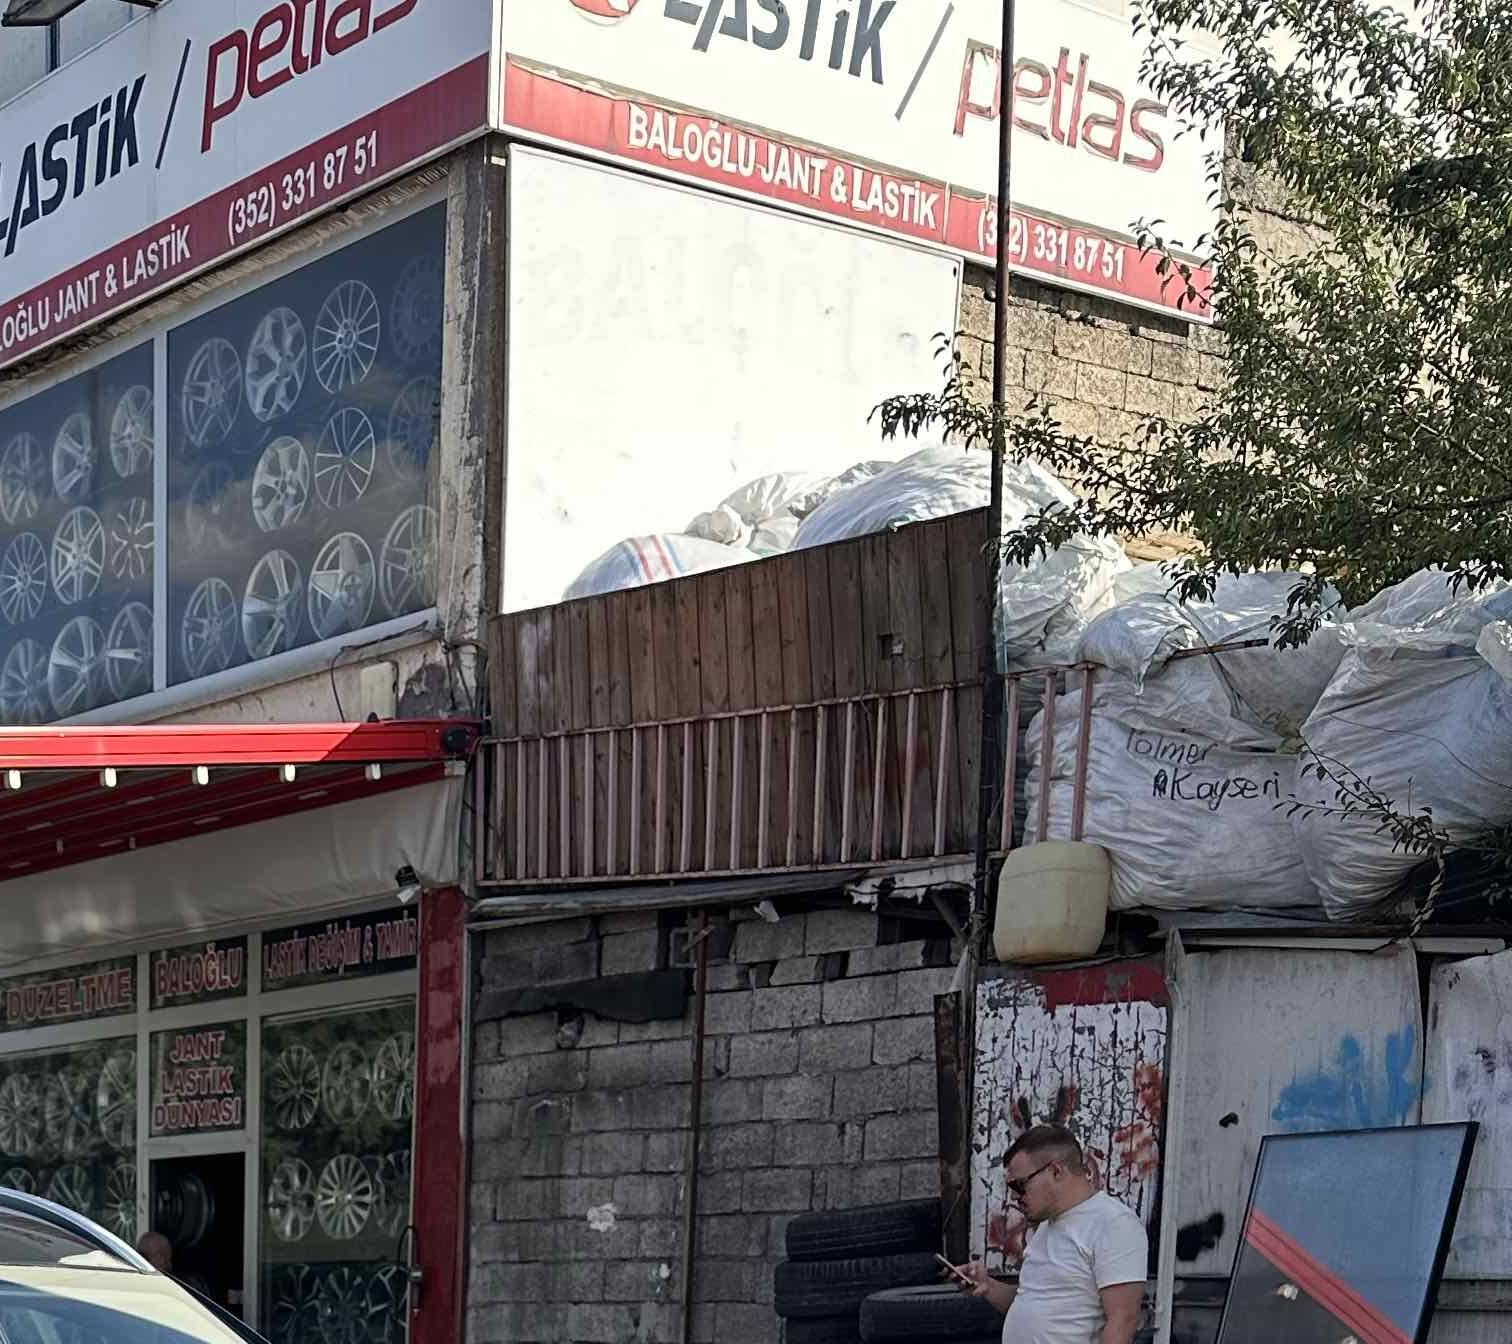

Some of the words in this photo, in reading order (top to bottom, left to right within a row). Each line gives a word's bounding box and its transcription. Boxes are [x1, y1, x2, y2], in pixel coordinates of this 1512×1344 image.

[952, 38, 1168, 173] petlas
[54, 271, 101, 324] JANT
[104, 263, 118, 298] &
[122, 223, 191, 290] LASTİK
[227, 182, 277, 246] (352)
[281, 162, 316, 211] 331
[322, 145, 349, 190] 87
[354, 130, 378, 176] 51
[628, 102, 757, 178] BALOĞLU
[757, 141, 829, 201] JANT
[830, 165, 848, 204] &
[851, 170, 939, 230] LASTİK
[977, 207, 1029, 263] (32)
[1033, 225, 1070, 266] 331
[155, 943, 243, 997] BALOĞLU
[162, 1060, 234, 1097] LASTİK
[169, 1030, 226, 1063] JANT
